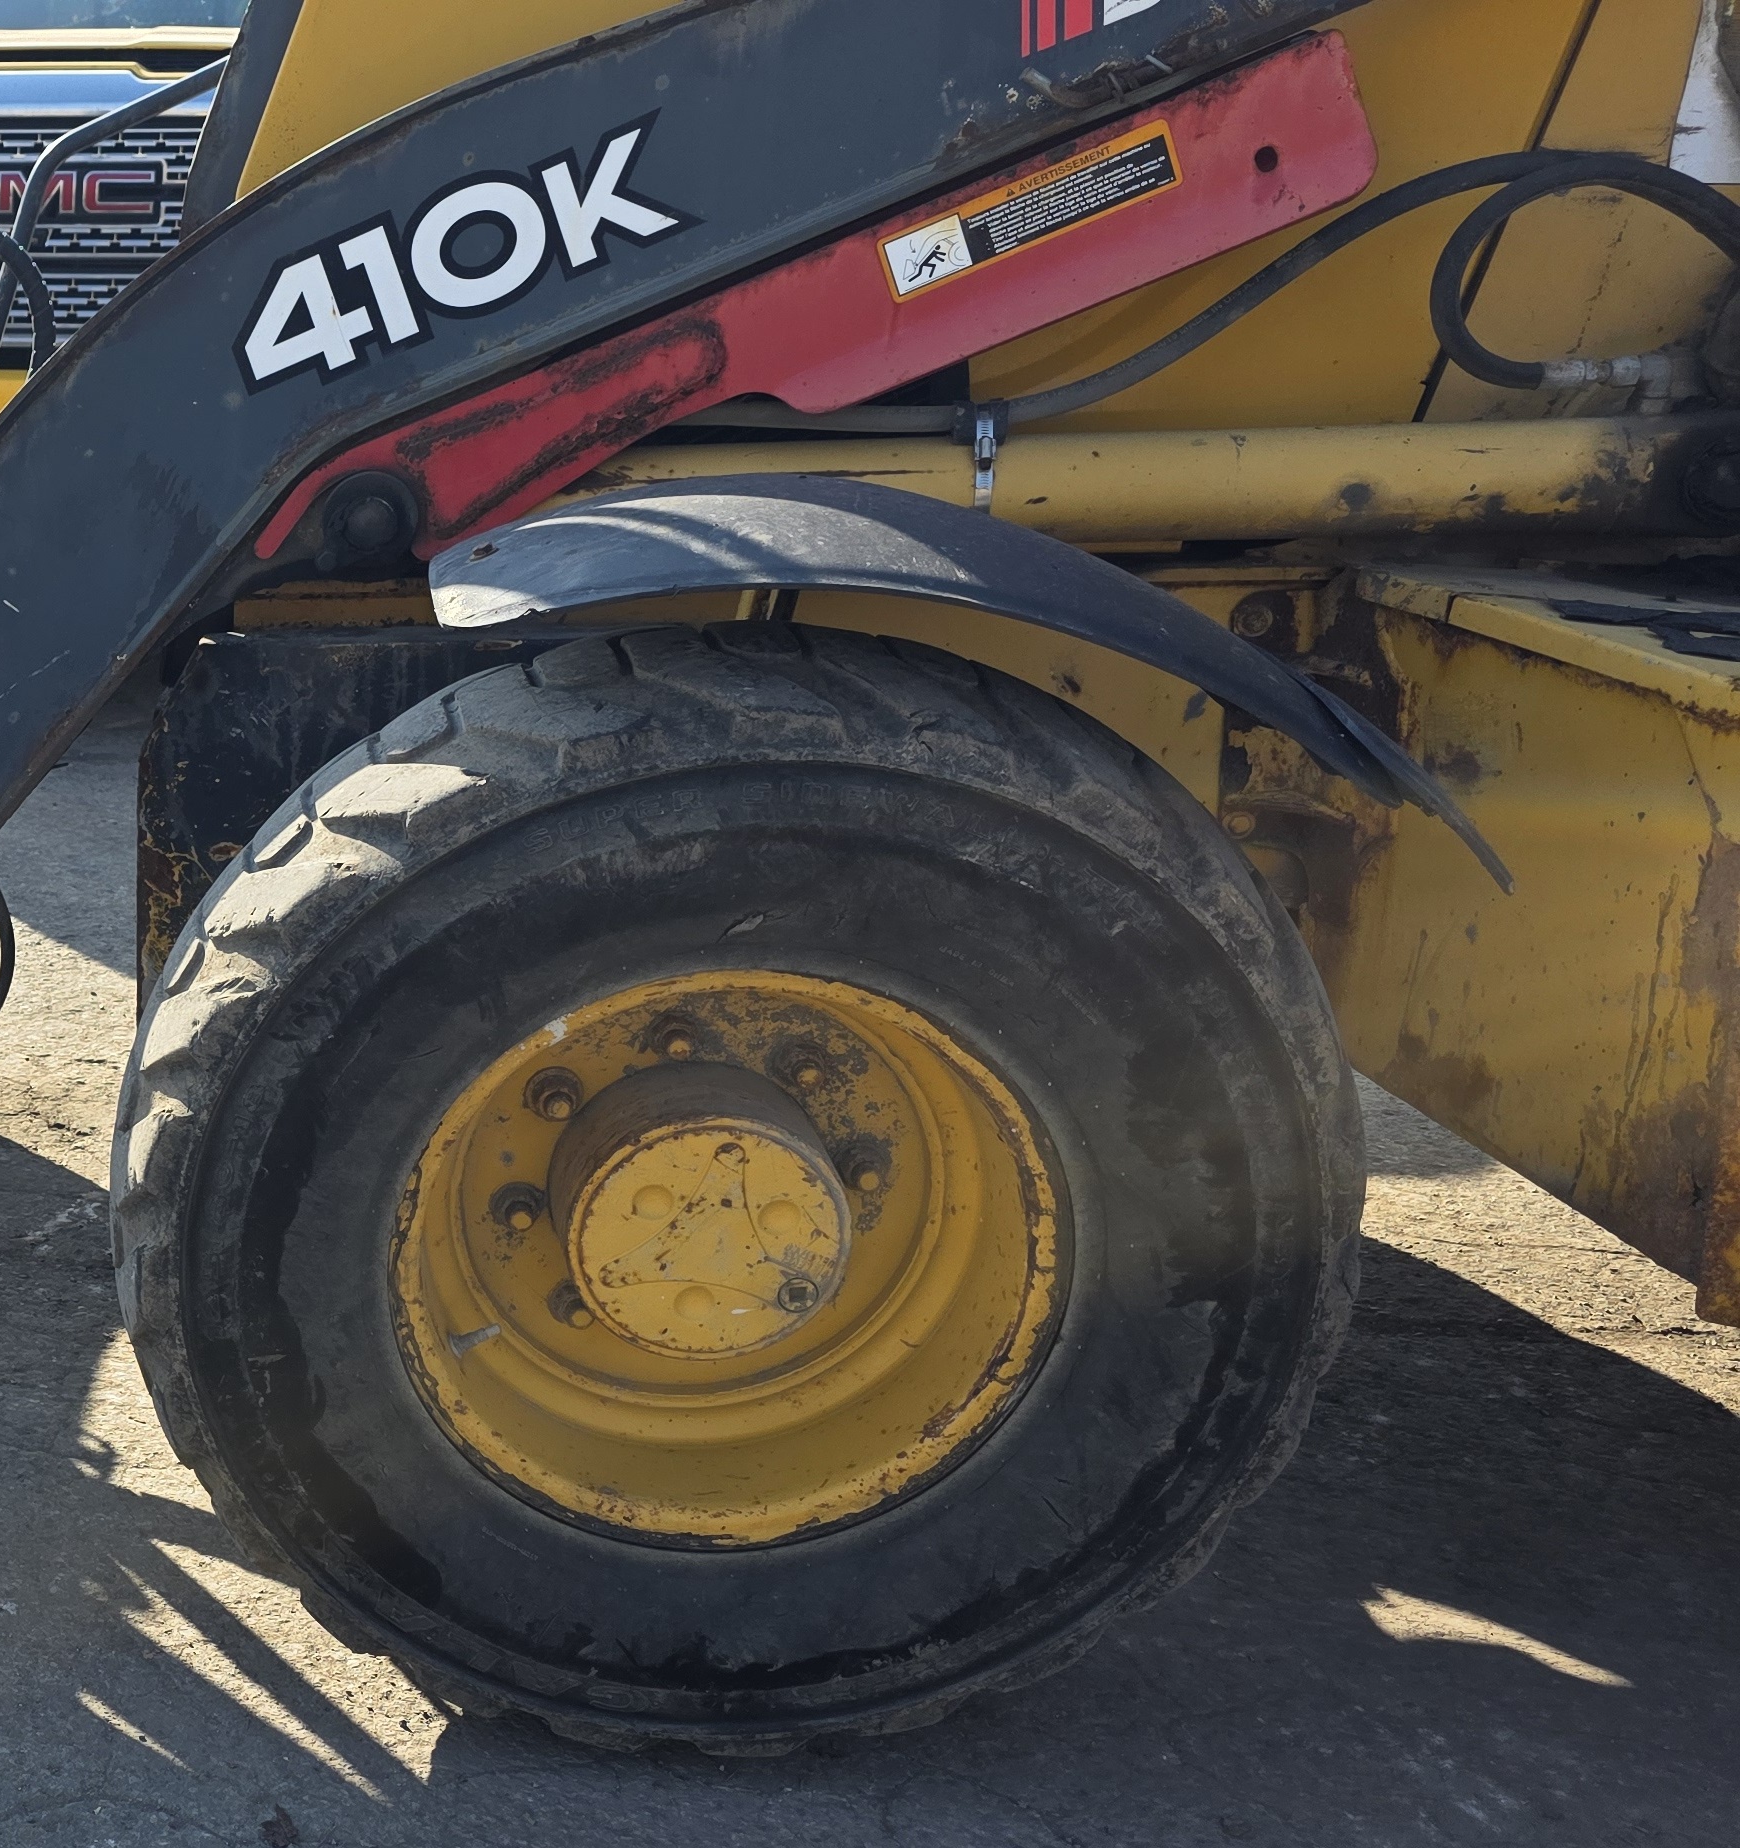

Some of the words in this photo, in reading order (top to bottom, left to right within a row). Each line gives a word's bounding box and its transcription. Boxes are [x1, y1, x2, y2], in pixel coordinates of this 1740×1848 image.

[1019, 145, 1111, 191] AVERTISSEMENT
[245, 128, 679, 381] 410K
[522, 787, 704, 856] SUPER
